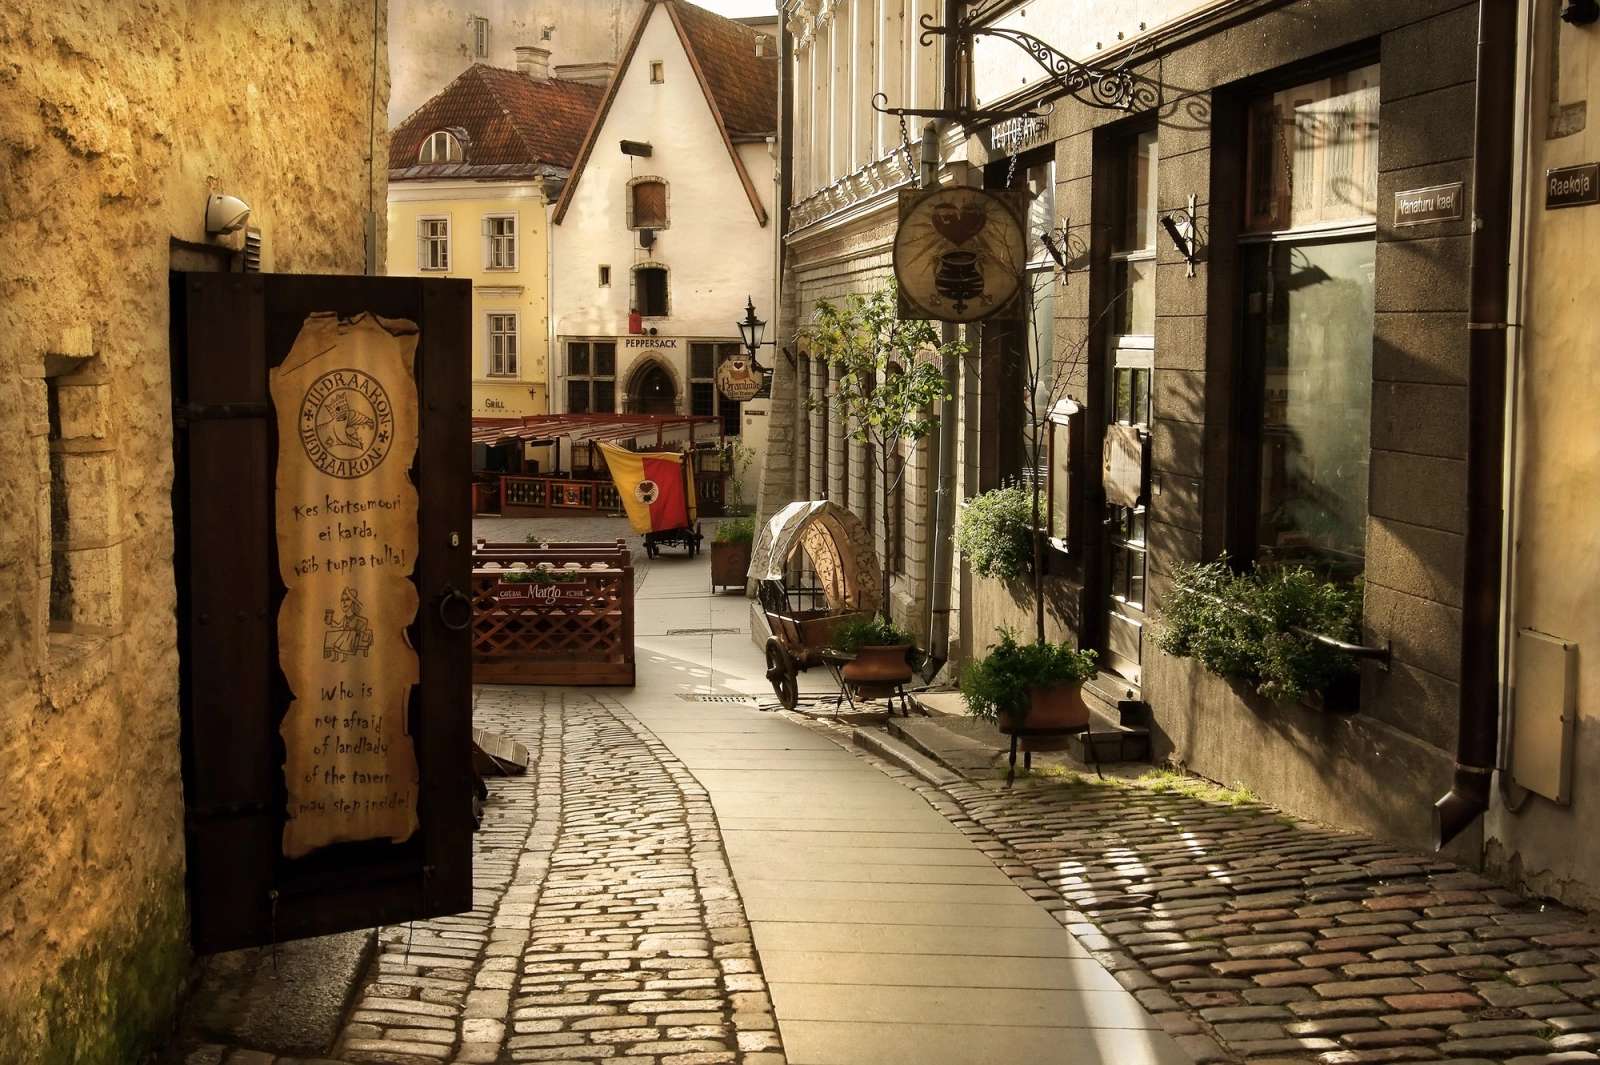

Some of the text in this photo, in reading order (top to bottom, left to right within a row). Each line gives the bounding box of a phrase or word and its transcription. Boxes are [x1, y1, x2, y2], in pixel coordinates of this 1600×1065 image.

[1550, 173, 1590, 196] Raekoja
[1400, 197, 1434, 215] Vanaturu
[625, 339, 677, 348] PEPPERSACK
[292, 494, 401, 521] Kes kõrtsumoori
[318, 520, 377, 542] ei karda,
[294, 544, 406, 577] võib tuppa tulla!
[527, 584, 561, 605] Margo
[321, 681, 373, 701] Who is
[315, 711, 383, 733] not afraid
[313, 735, 388, 758] of landlady
[305, 765, 393, 785] of the tavern
[300, 790, 410, 816] may step inside!
